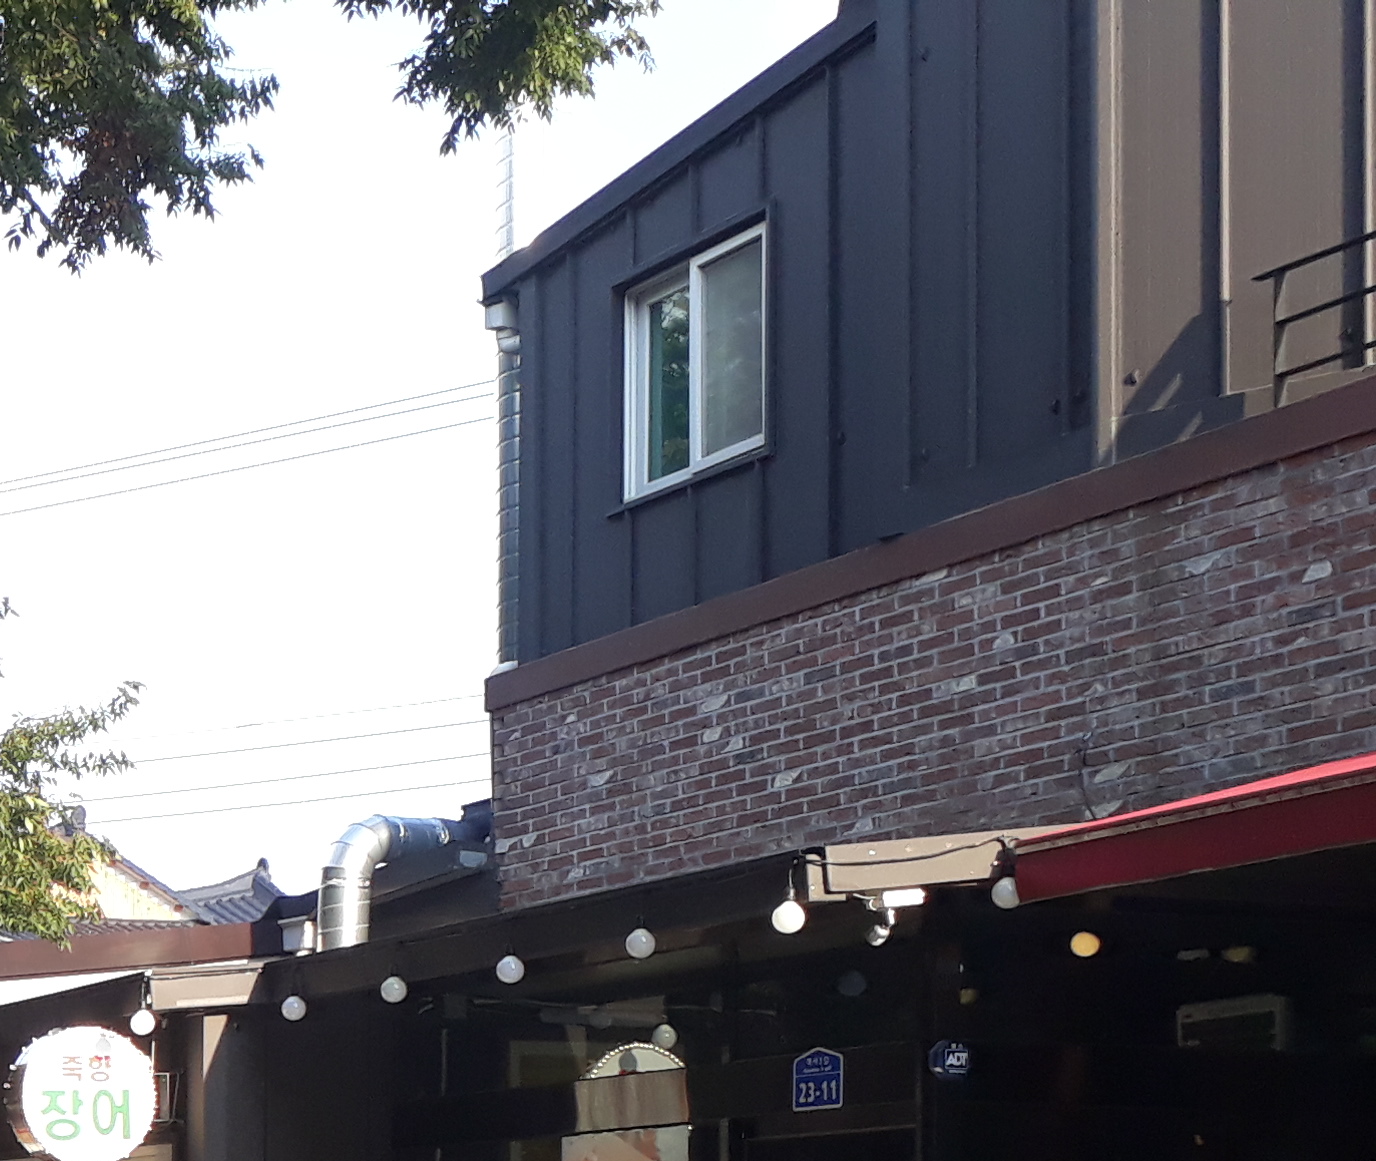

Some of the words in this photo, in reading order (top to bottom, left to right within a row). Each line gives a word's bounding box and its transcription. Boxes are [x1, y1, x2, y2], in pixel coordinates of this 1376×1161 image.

[61, 1055, 112, 1082] 죽향
[945, 1052, 968, 1067] ADT
[798, 1079, 838, 1104] 23-11
[40, 1089, 131, 1141] 장어
